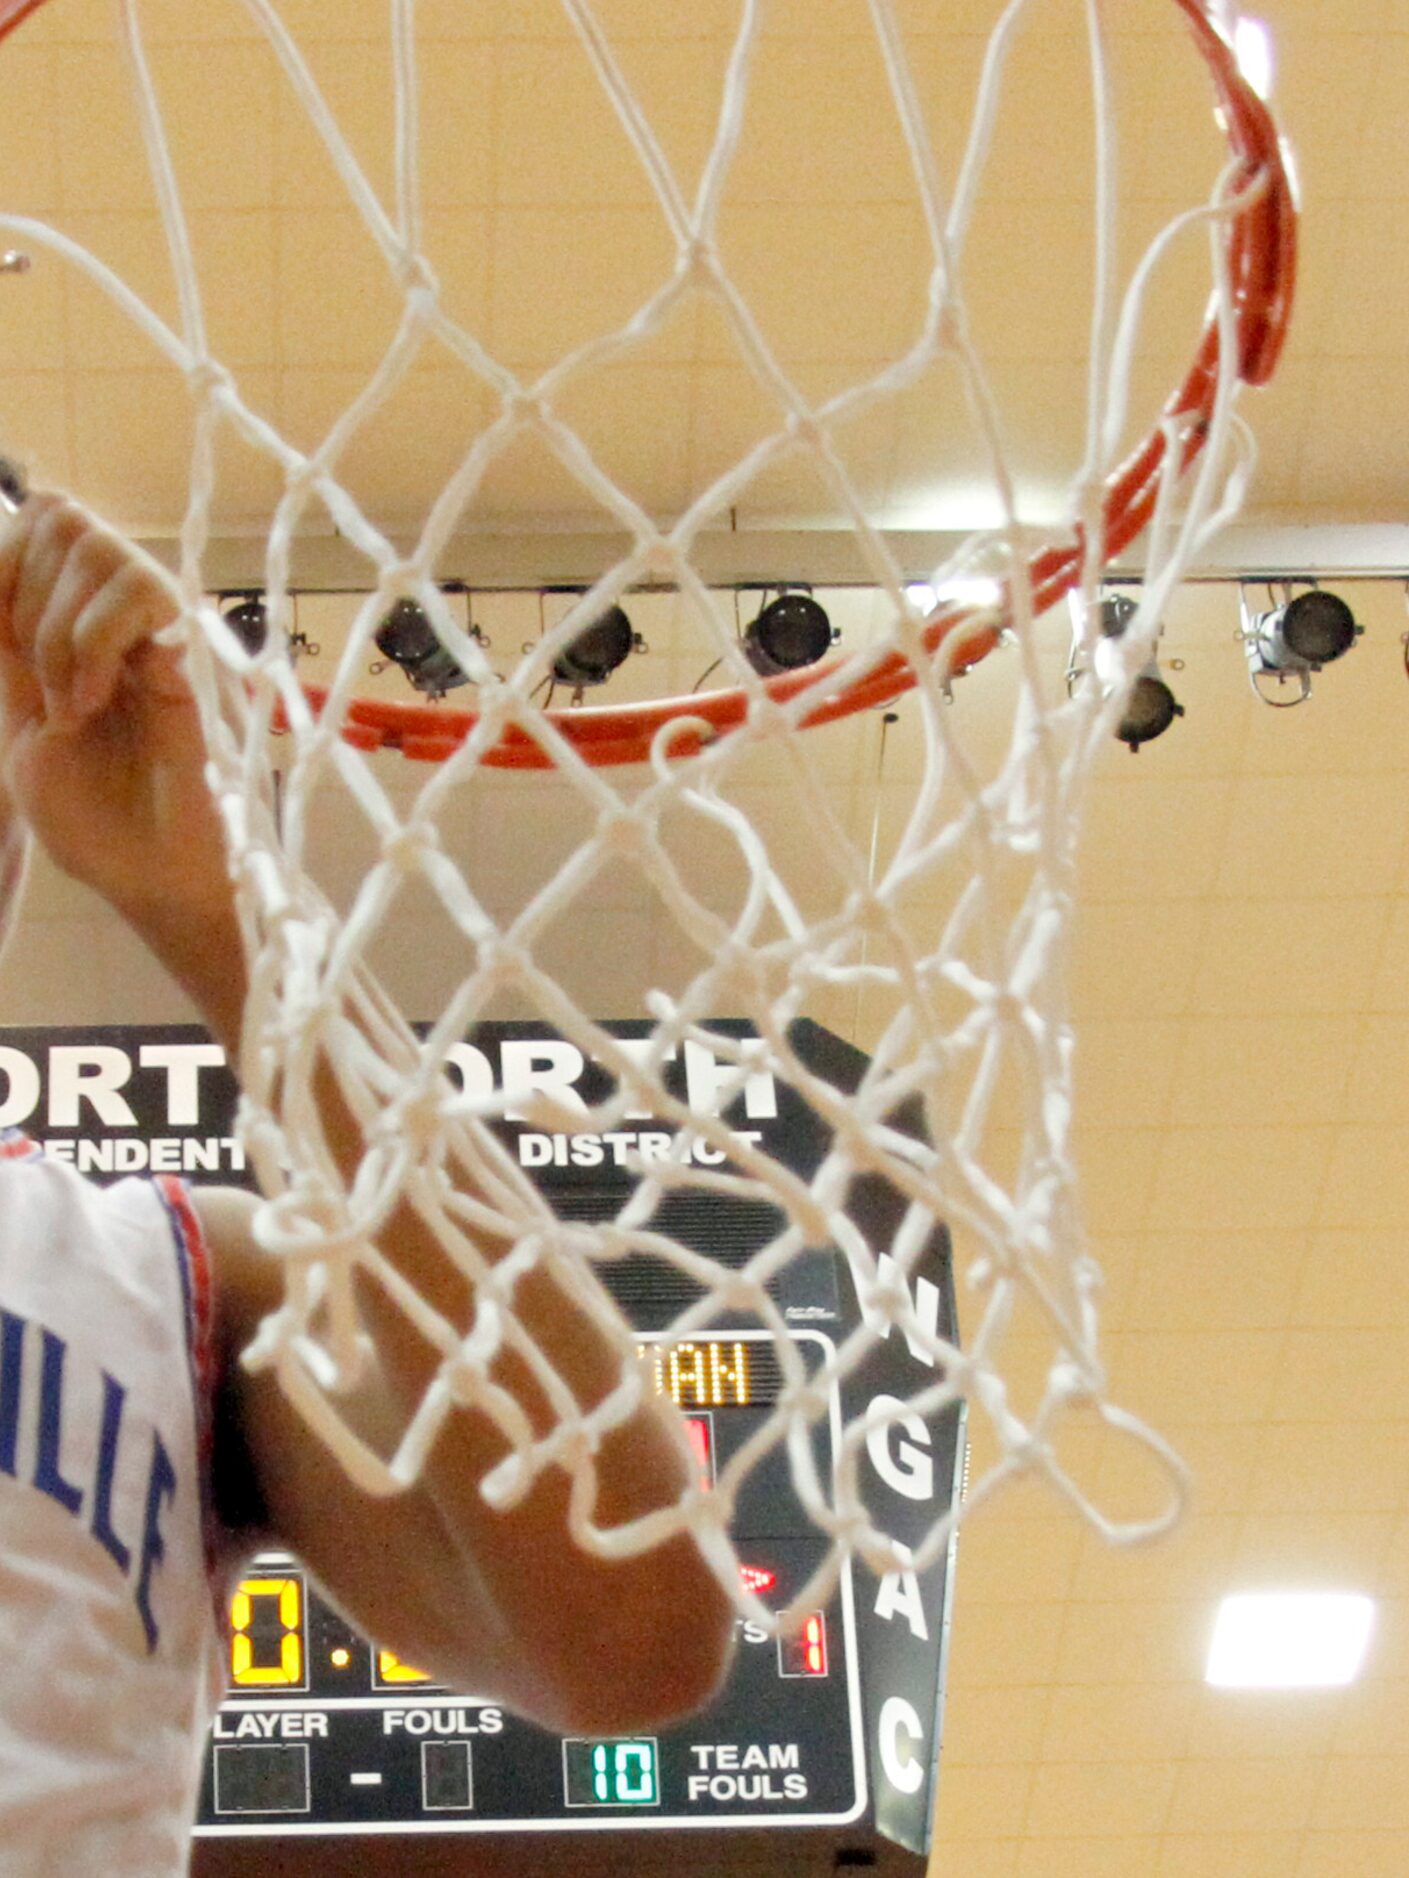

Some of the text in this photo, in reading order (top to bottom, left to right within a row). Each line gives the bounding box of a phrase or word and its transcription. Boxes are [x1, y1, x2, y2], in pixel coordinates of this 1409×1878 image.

[416, 1038, 777, 1121] ORTH
[32, 1137, 246, 1172] ENDENT
[212, 1708, 503, 1738] LAYER FOULS
[594, 1744, 654, 1800] 10
[690, 1744, 800, 1769] TEAM
[688, 1775, 809, 1800] FOULS
